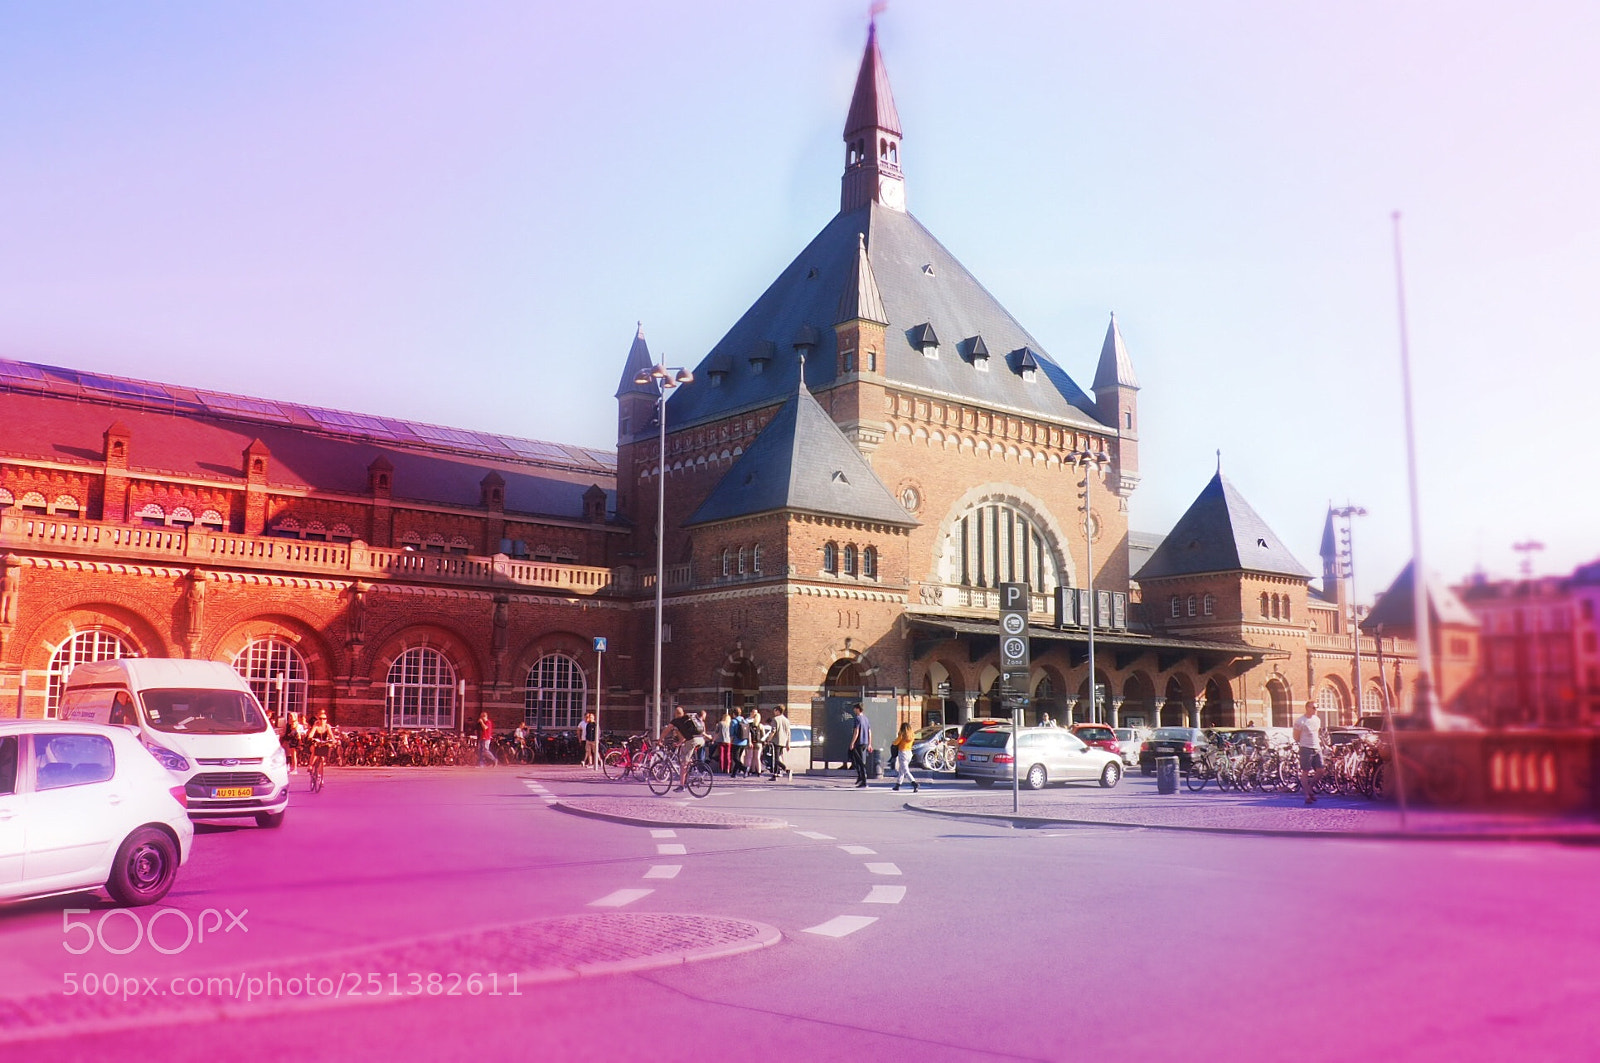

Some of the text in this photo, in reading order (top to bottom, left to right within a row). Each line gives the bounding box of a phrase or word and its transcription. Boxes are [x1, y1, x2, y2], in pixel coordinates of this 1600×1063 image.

[1007, 587, 1020, 606] P
[1008, 643, 1021, 652] 30
[1003, 673, 1010, 681] P
[216, 789, 226, 797] AU
[237, 788, 251, 796] 640
